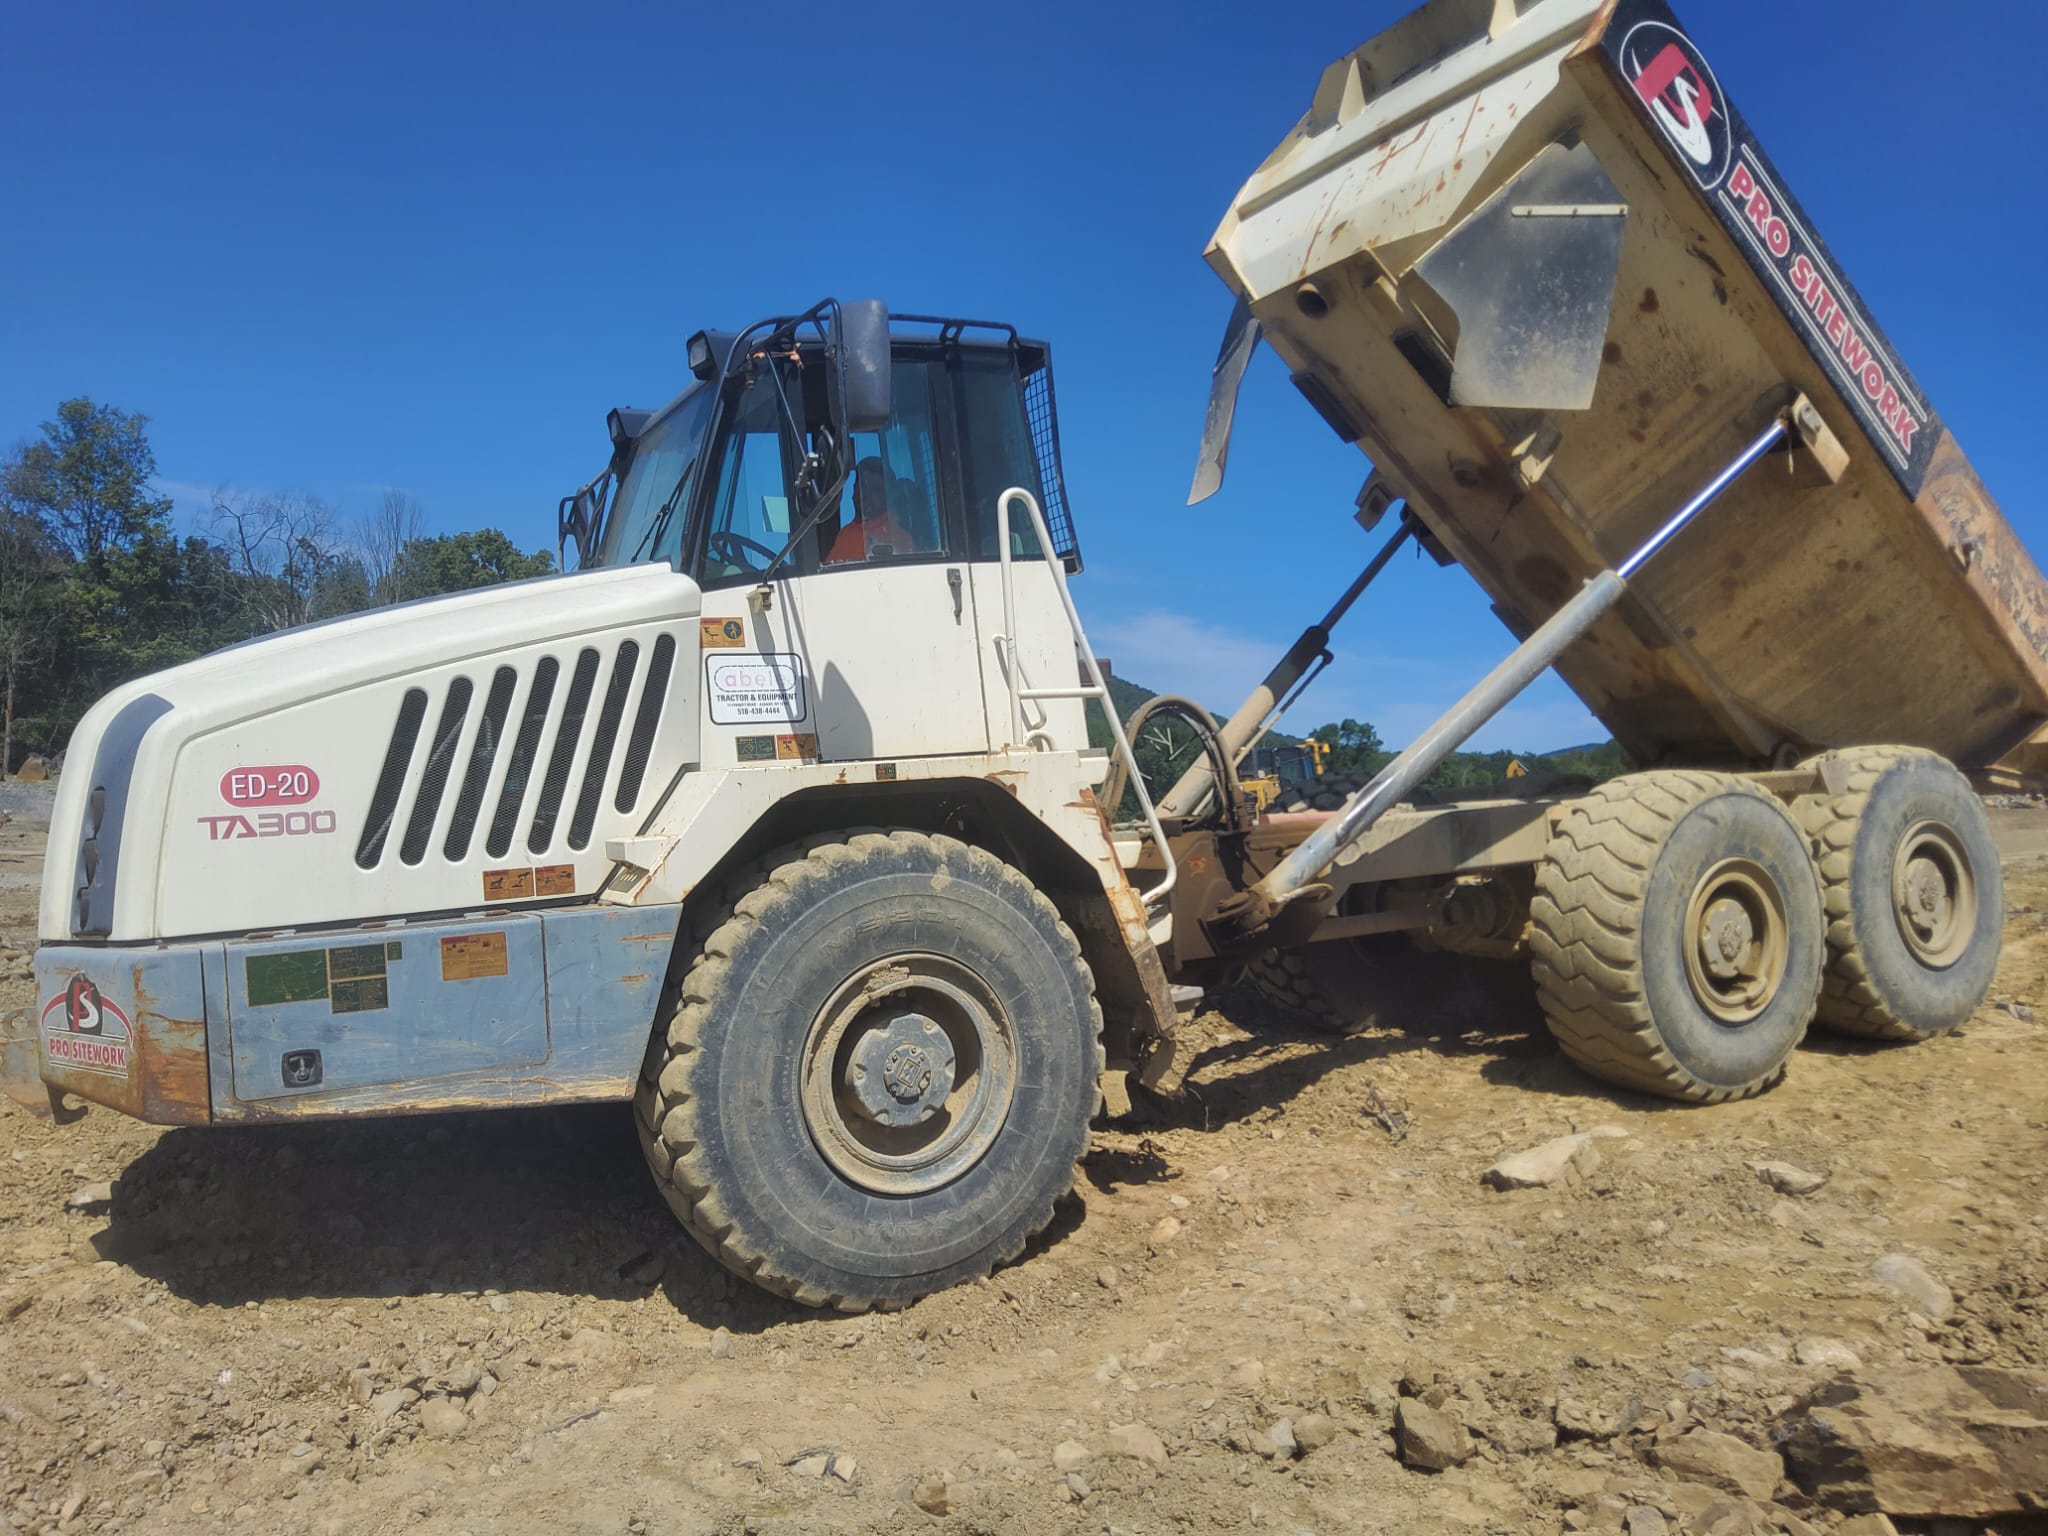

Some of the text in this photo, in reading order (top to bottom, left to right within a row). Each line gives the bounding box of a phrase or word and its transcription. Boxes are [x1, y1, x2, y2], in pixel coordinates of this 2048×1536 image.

[1728, 160, 1919, 454] PRO SITEWORK
[725, 671, 790, 687] abel
[717, 694, 749, 702] TRACTOR
[758, 693, 798, 701] EQUIPMENT
[231, 772, 310, 799] ED-20
[197, 810, 336, 840] TA300
[49, 1038, 127, 1069] PRO SITEWORK
